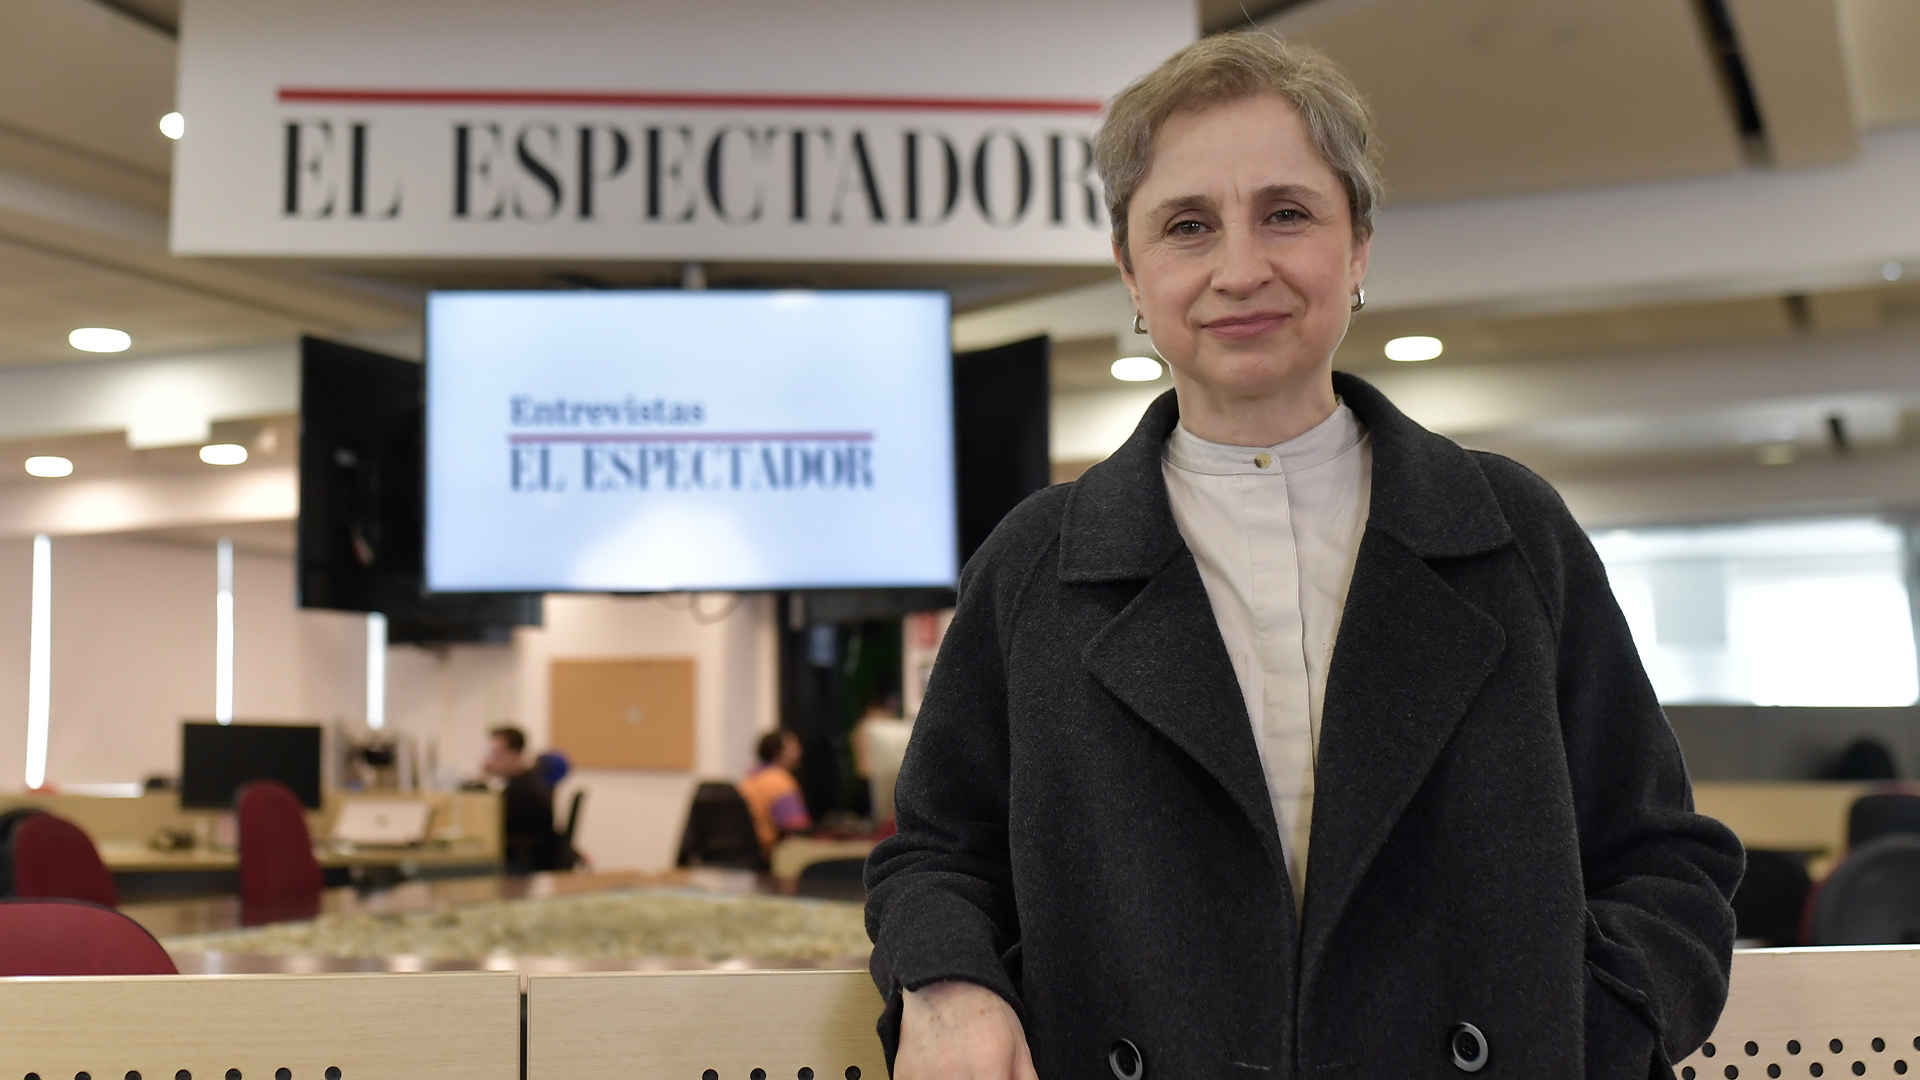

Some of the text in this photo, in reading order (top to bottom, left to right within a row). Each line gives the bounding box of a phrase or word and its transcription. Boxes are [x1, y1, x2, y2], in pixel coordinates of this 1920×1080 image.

[281, 120, 1102, 228] EL ESPECTADOR
[509, 394, 705, 427] Entrevistas
[510, 445, 875, 491] EL ESPECTADOR
